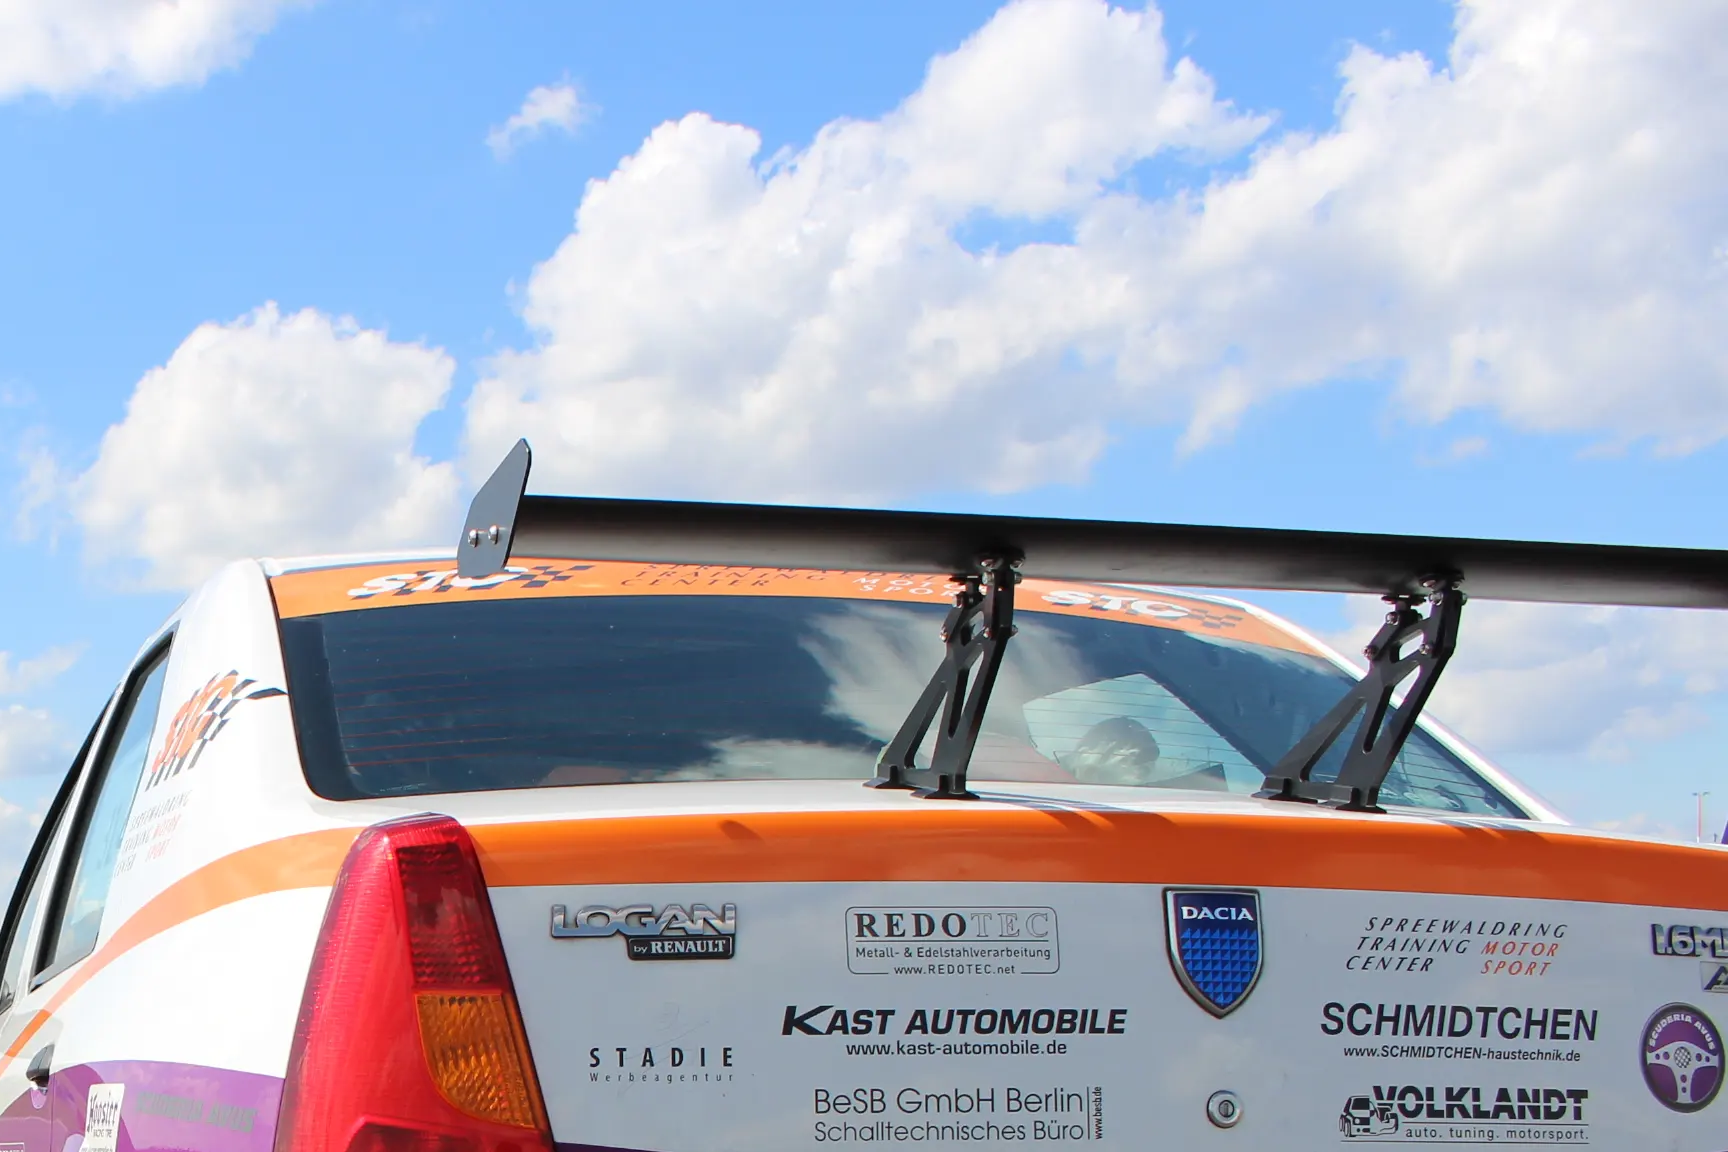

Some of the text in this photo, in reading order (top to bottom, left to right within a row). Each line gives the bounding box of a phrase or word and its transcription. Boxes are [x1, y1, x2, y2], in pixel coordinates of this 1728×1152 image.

[620, 578, 770, 587] CENTER
[859, 584, 962, 598] SPOR
[1041, 589, 1191, 618] STC
[551, 903, 736, 939] LOGAN
[1180, 906, 1254, 922] DACIA
[854, 912, 1050, 938] REDOTEC
[1365, 916, 1569, 938] SPREEWALDRING
[633, 940, 726, 954] by RENAULT
[1356, 936, 1560, 957] TRAINING MOTOR
[1651, 924, 1728, 958] 1.6M
[855, 945, 1051, 960] Metall- & Edelstahlverarbeitung
[894, 964, 1016, 975] www.REDOTEC.net
[1346, 955, 1552, 976] CENTER SPORT
[781, 1004, 1128, 1036] KAST AUTOMOBILE
[1320, 1001, 1599, 1041] SCHMIDTCHEN
[1648, 1013, 1717, 1051] SCUDERIA AVUS
[589, 1047, 733, 1068] STADIE
[846, 1040, 1068, 1055] www.kast-automobile.de
[1343, 1045, 1581, 1062] www.SCHMIDTCHEN-haustechnik.de
[589, 1072, 733, 1084] Werbeagentur
[814, 1087, 1084, 1114] BeSB GmbH Berlin
[1372, 1085, 1589, 1121] VOLKLANDT
[205, 1102, 258, 1133] AVUS
[813, 1119, 1084, 1142] Schalltechnisches Büro
[1405, 1127, 1589, 1141] auto. tuning. motorsport.
